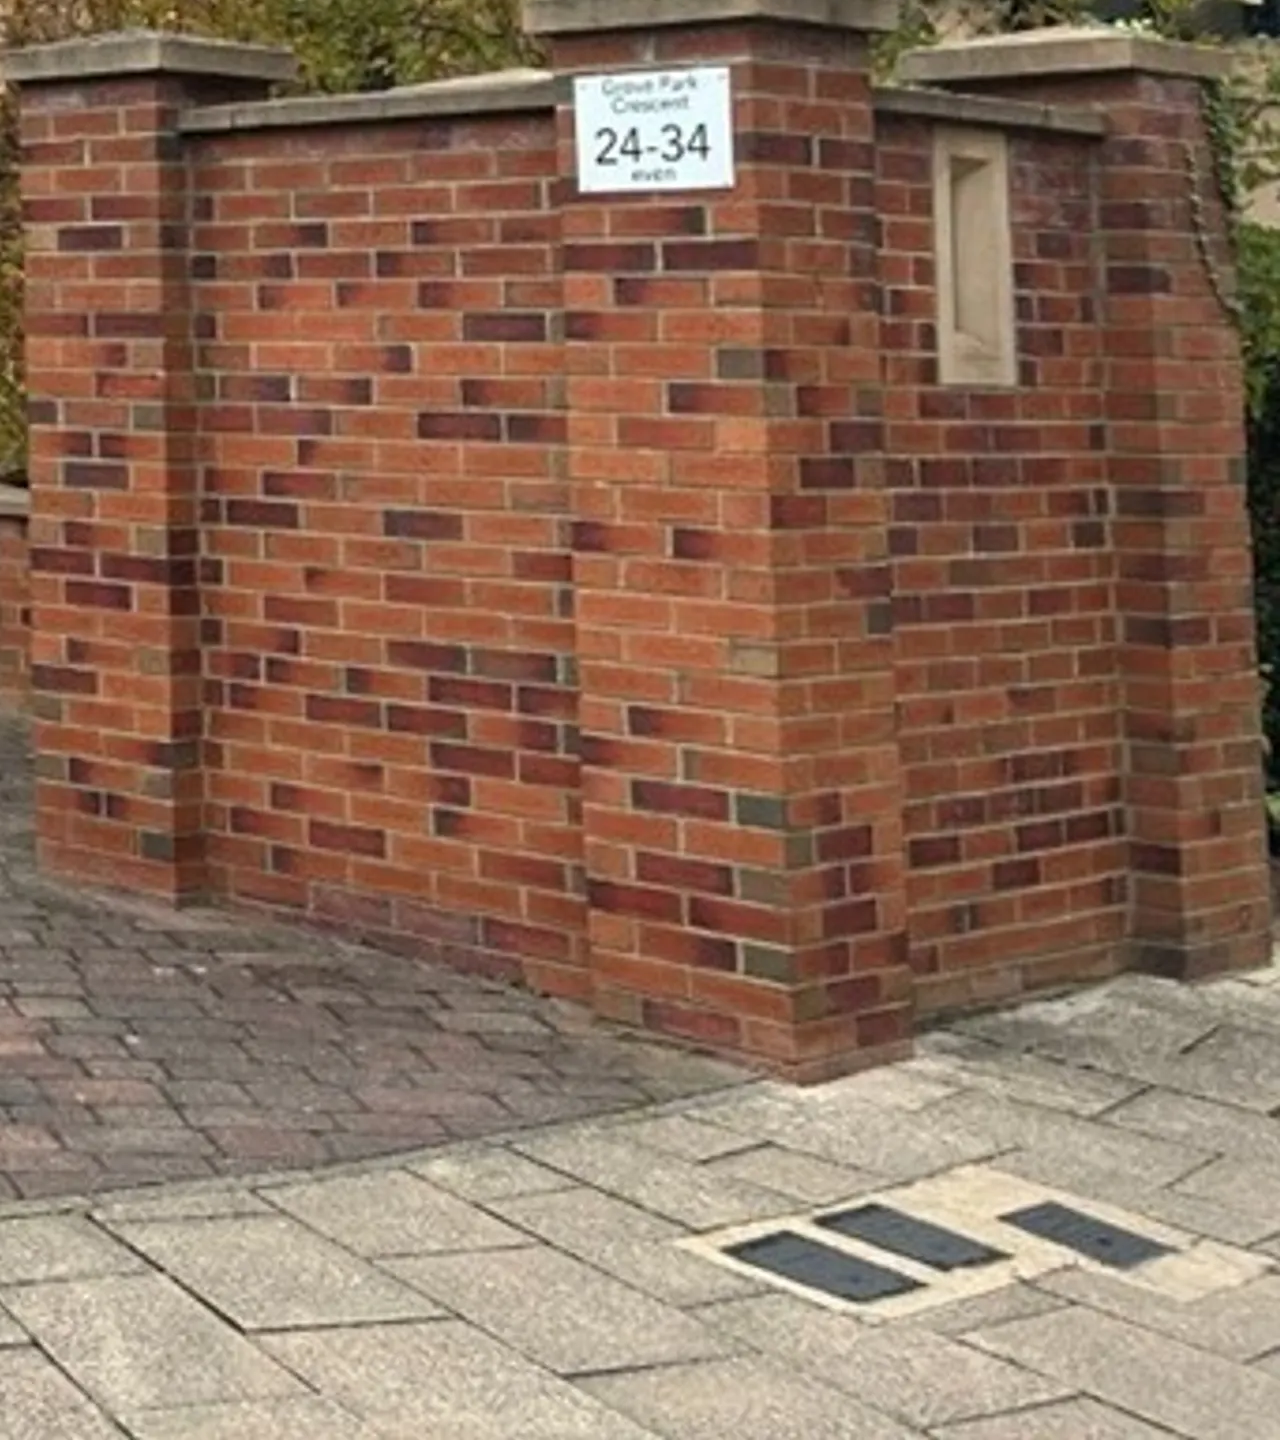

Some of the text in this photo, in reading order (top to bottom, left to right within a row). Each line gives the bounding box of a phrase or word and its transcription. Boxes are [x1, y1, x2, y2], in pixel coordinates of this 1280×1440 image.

[602, 75, 696, 96] Grove Park
[610, 96, 689, 114] Crescent
[595, 123, 711, 165] 24-34
[631, 168, 677, 181] even
